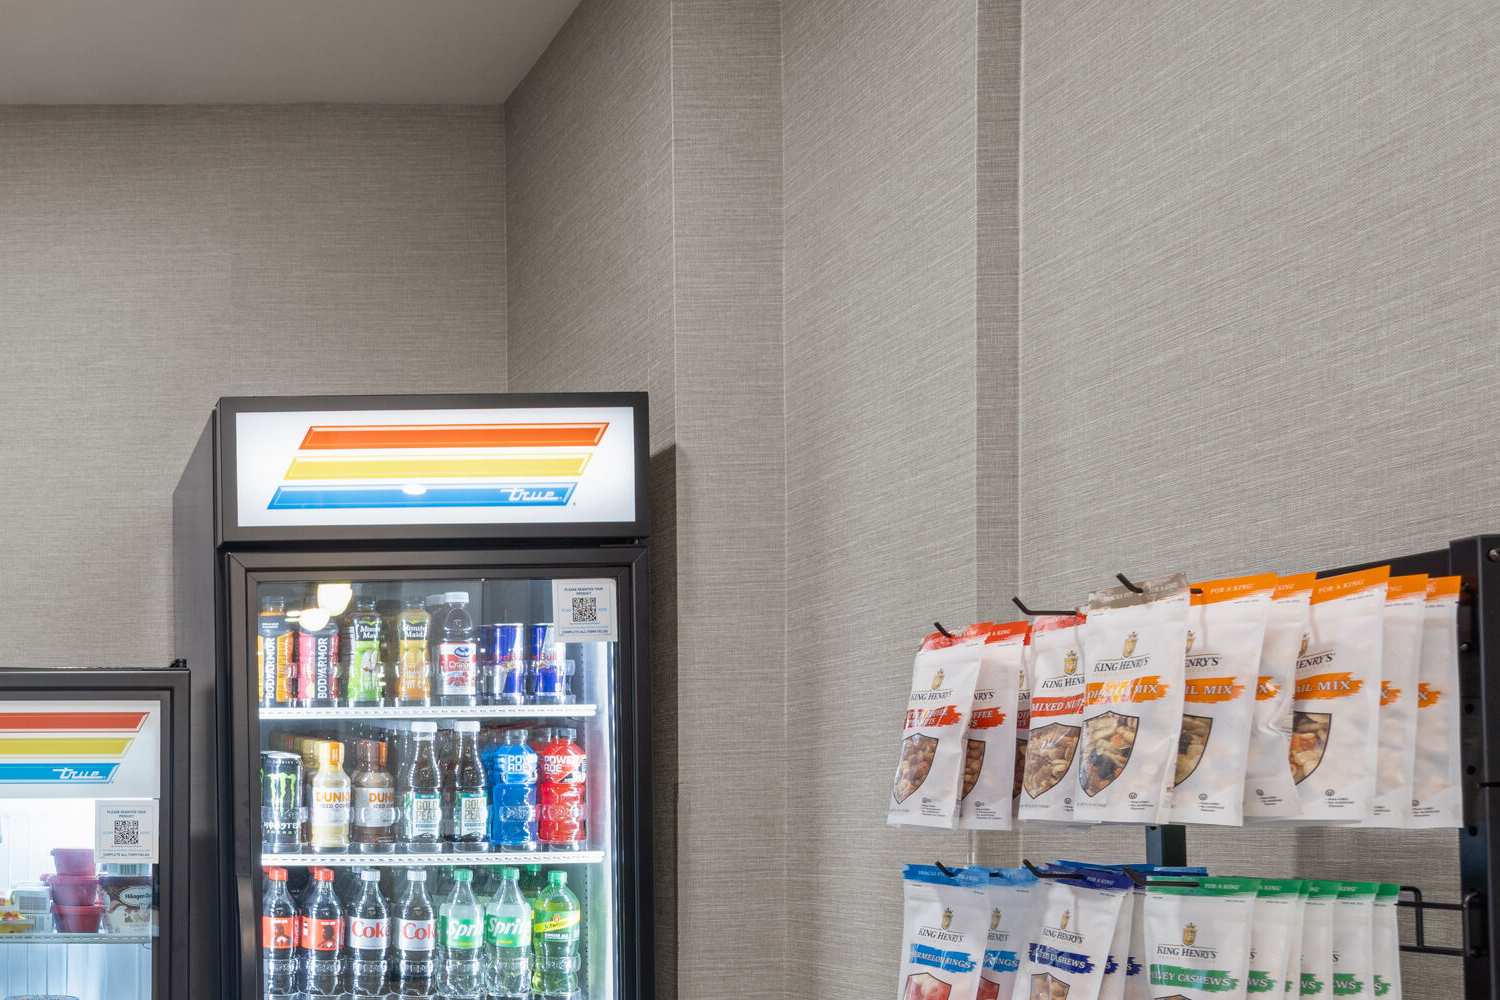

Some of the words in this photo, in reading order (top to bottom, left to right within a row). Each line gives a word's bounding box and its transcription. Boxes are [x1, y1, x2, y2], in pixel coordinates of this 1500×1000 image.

[265, 637, 276, 699] BODYARMOR
[317, 637, 328, 699] BODYARMOR
[1094, 660, 1118, 673] KING
[1119, 656, 1149, 671] HENRY'S
[1135, 684, 1158, 694] MIX
[1204, 684, 1233, 695] MIX
[1317, 680, 1351, 692] MIX
[911, 690, 927, 701] KING
[543, 763, 562, 772] ADE
[416, 800, 438, 811] GOLD
[918, 928, 938, 939] KING
[939, 932, 964, 943] HENRY'S
[1058, 932, 1084, 944] HENRY'S
[1157, 945, 1181, 957] KING
[1181, 946, 1217, 960] HENRY'S
